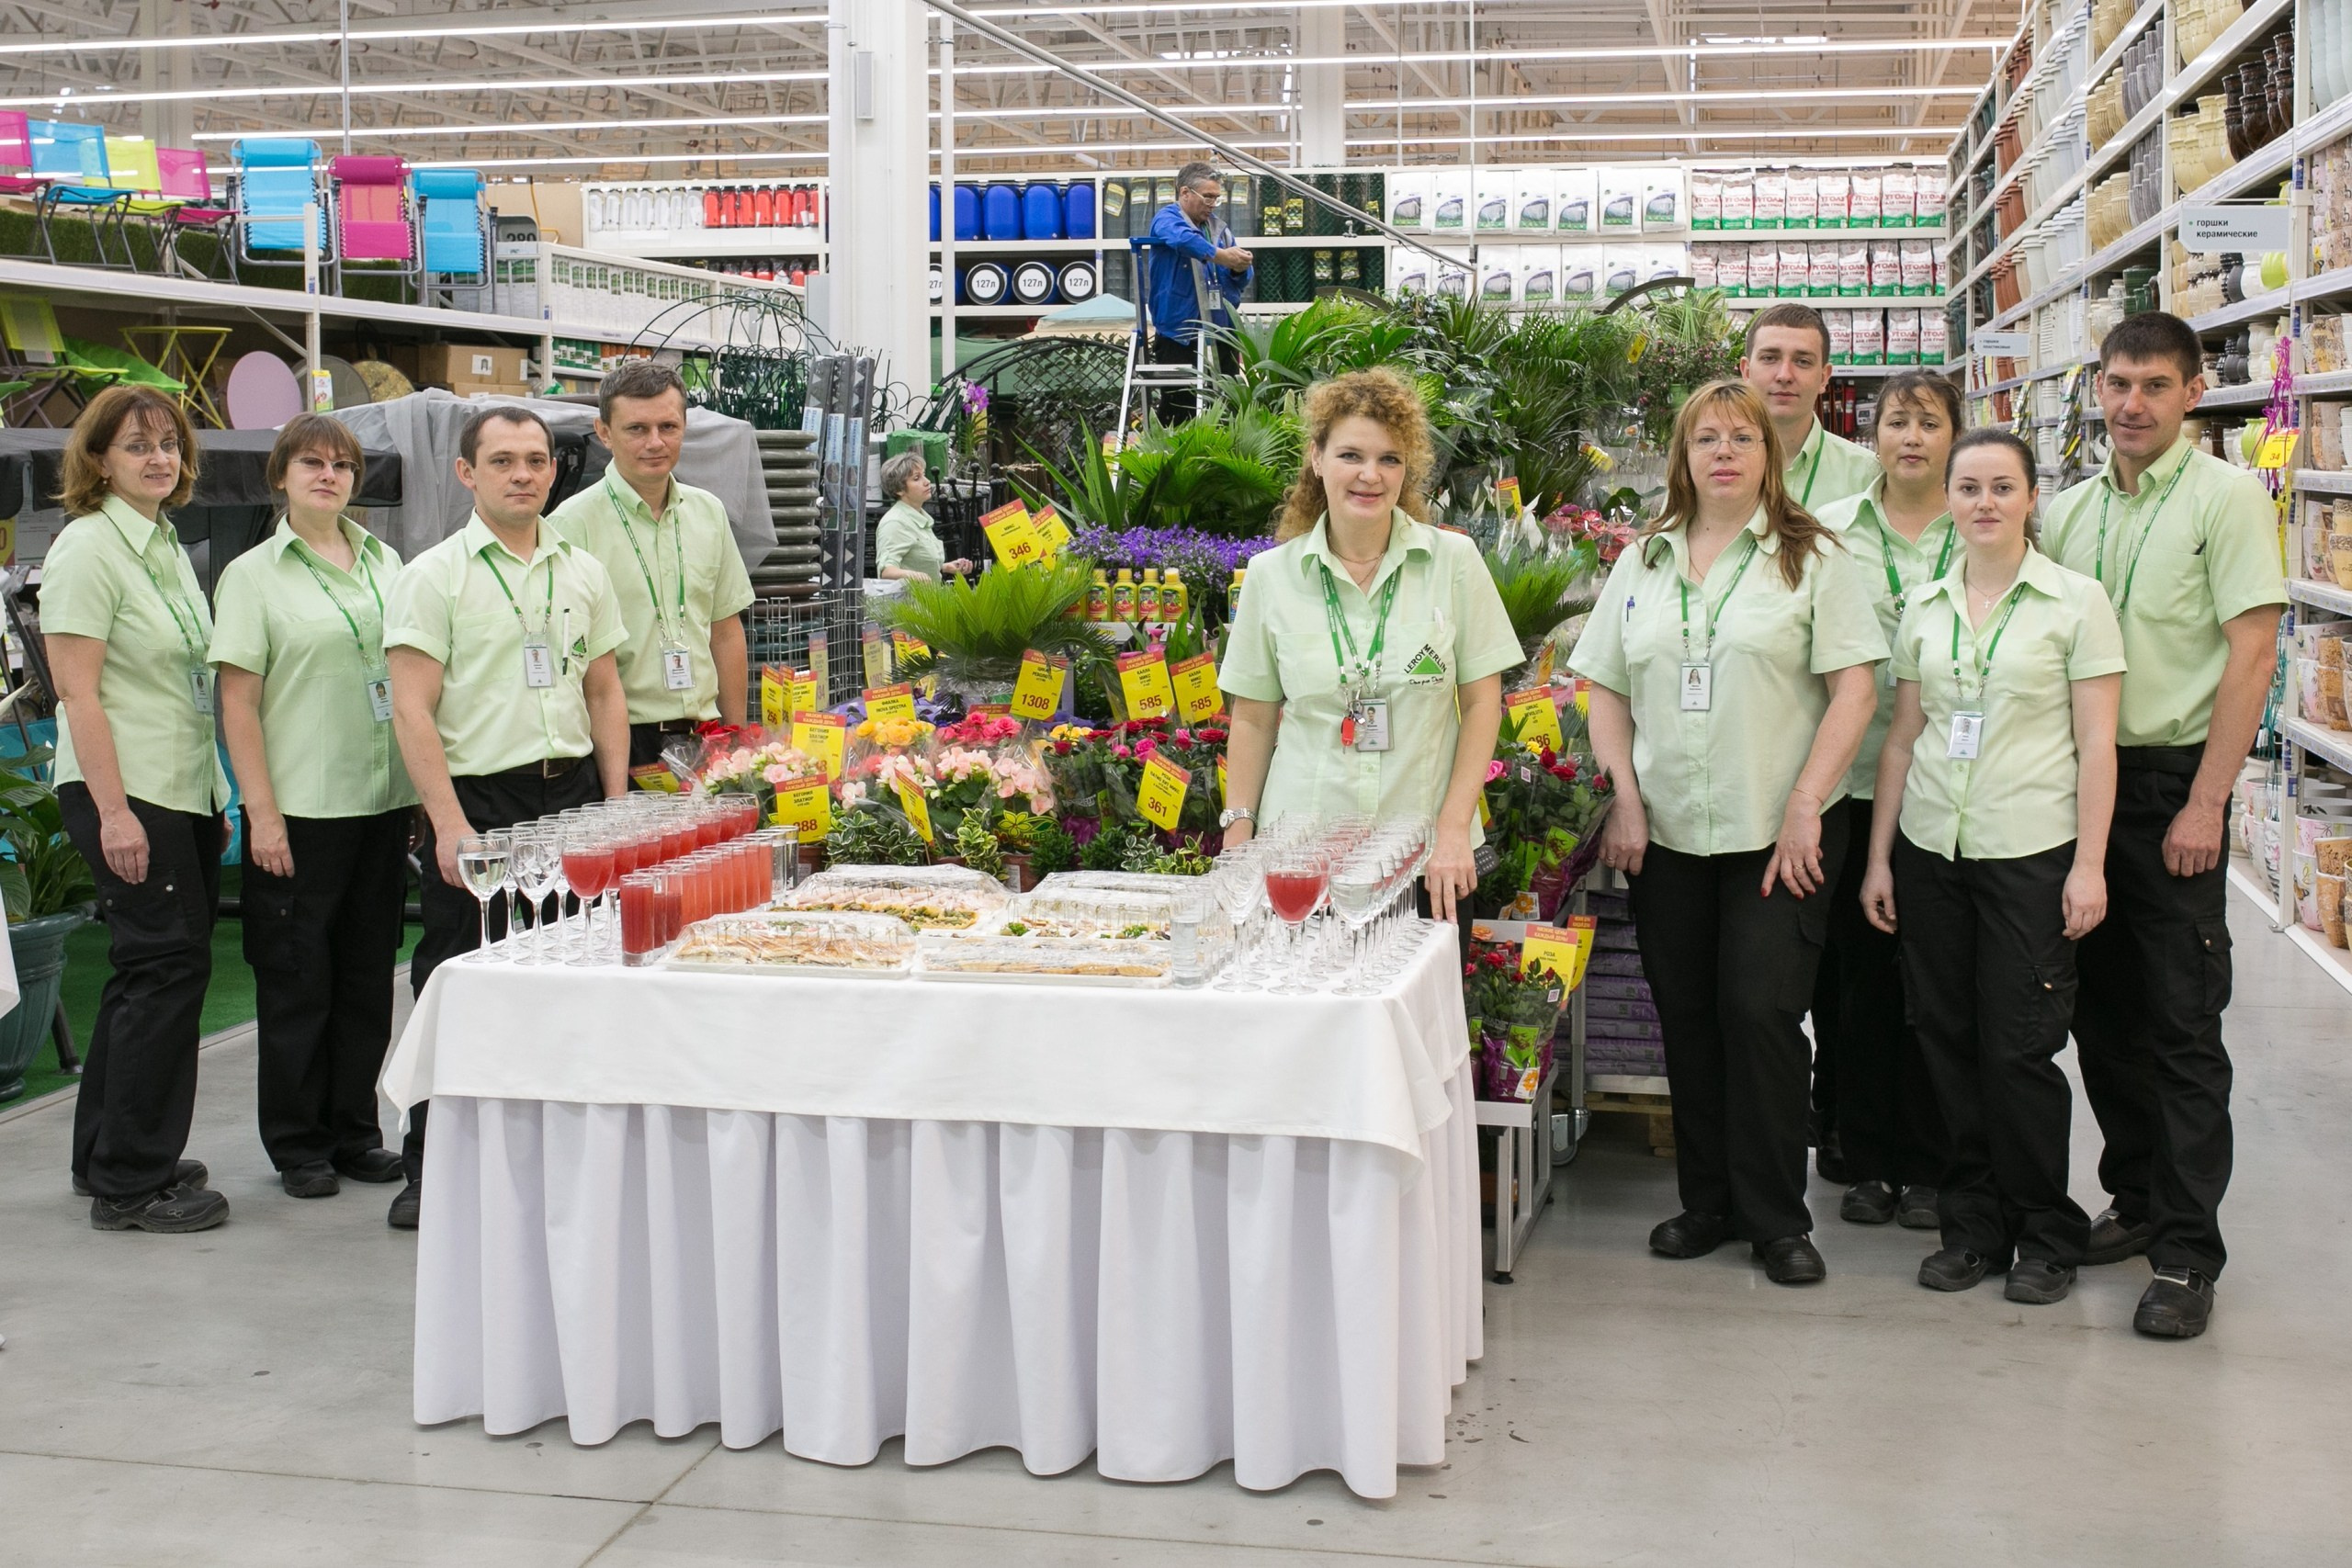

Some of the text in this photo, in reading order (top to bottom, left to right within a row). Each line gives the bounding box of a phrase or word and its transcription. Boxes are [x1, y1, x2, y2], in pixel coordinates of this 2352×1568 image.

[2196, 231, 2258, 239] керамические
[930, 280, 942, 288] 27л
[977, 279, 996, 288] 127л
[1023, 278, 1043, 287] 127л
[1069, 277, 1089, 287] 127л
[1009, 542, 1031, 558] 346
[1404, 643, 1447, 674] LEROY MERLIN
[1136, 667, 1150, 675] КАЛЛА
[1022, 694, 1049, 710] 1308
[1139, 694, 1162, 711] 585
[1191, 695, 1212, 712] 585
[1161, 772, 1170, 781] РОЗА
[1148, 796, 1168, 818] 361
